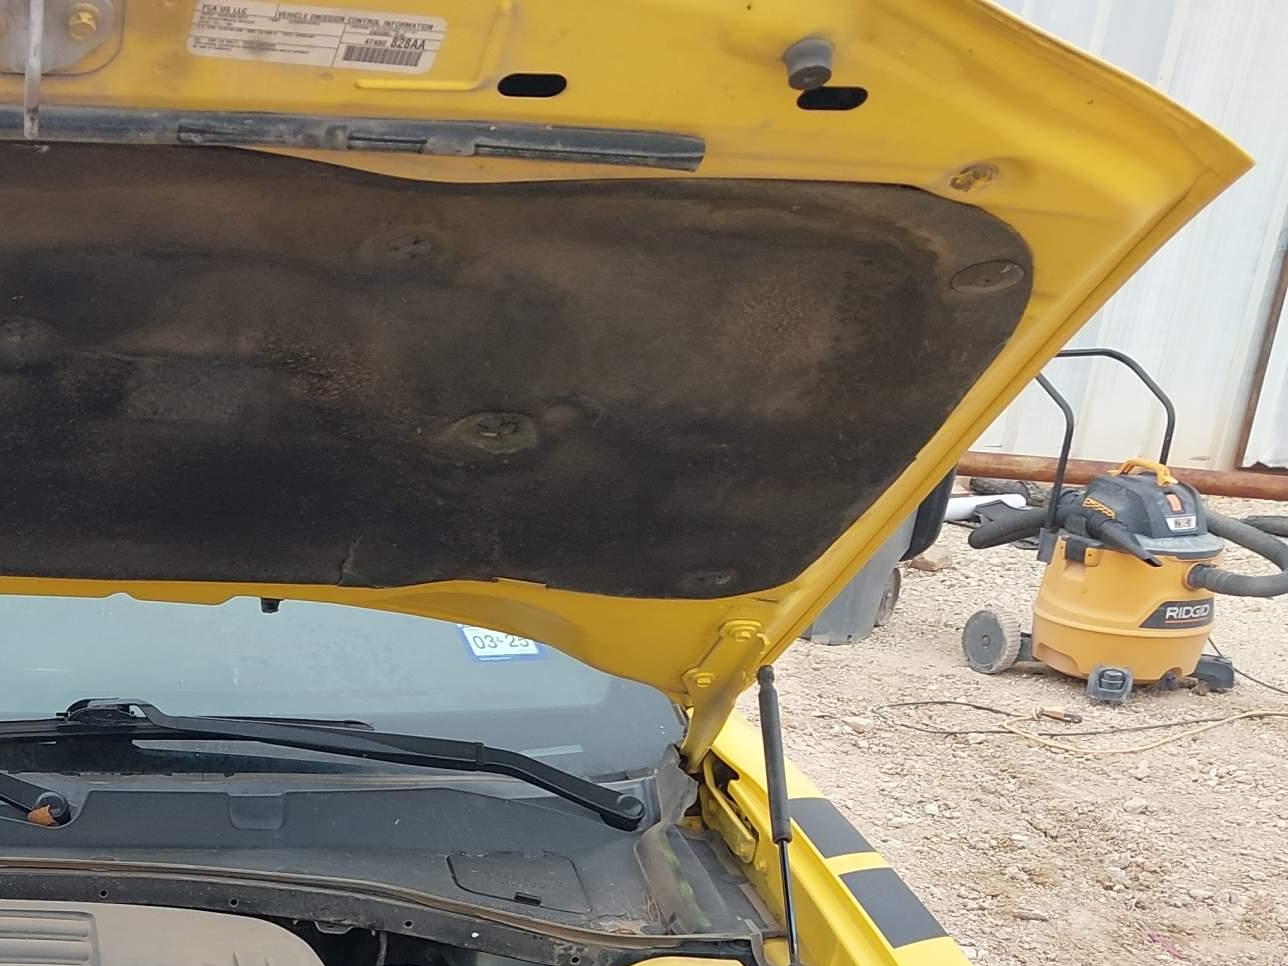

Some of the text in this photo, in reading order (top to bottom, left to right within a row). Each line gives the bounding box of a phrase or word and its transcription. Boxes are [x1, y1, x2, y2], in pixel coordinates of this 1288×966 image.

[348, 16, 380, 26] CONTROL
[383, 20, 435, 30] INFORMATION
[390, 38, 426, 50] 828AA
[1165, 604, 1210, 620] RIDGID
[472, 635, 498, 650] 03
